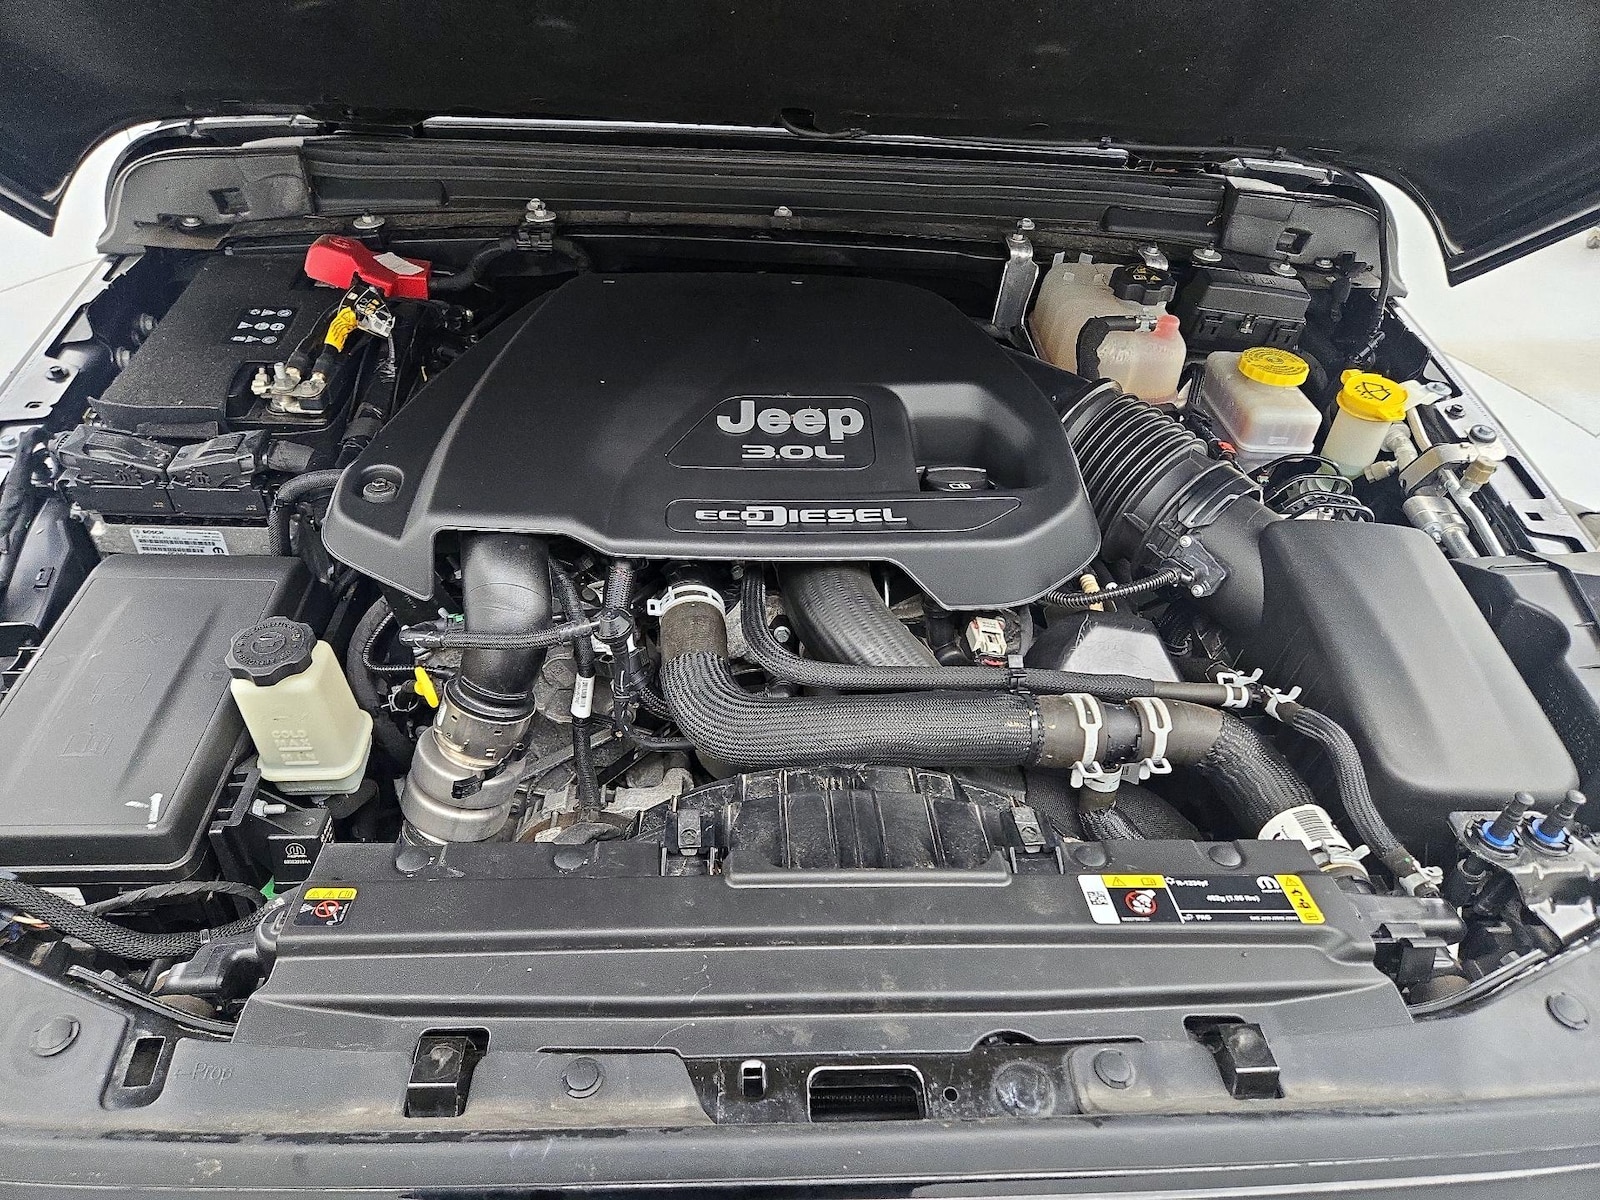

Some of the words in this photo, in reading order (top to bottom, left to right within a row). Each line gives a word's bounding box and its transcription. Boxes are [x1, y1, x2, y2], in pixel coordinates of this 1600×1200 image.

[716, 400, 865, 442] Jeep
[741, 444, 845, 461] 3.0L
[271, 729, 307, 739] COLD
[192, 1062, 232, 1085] Prop
